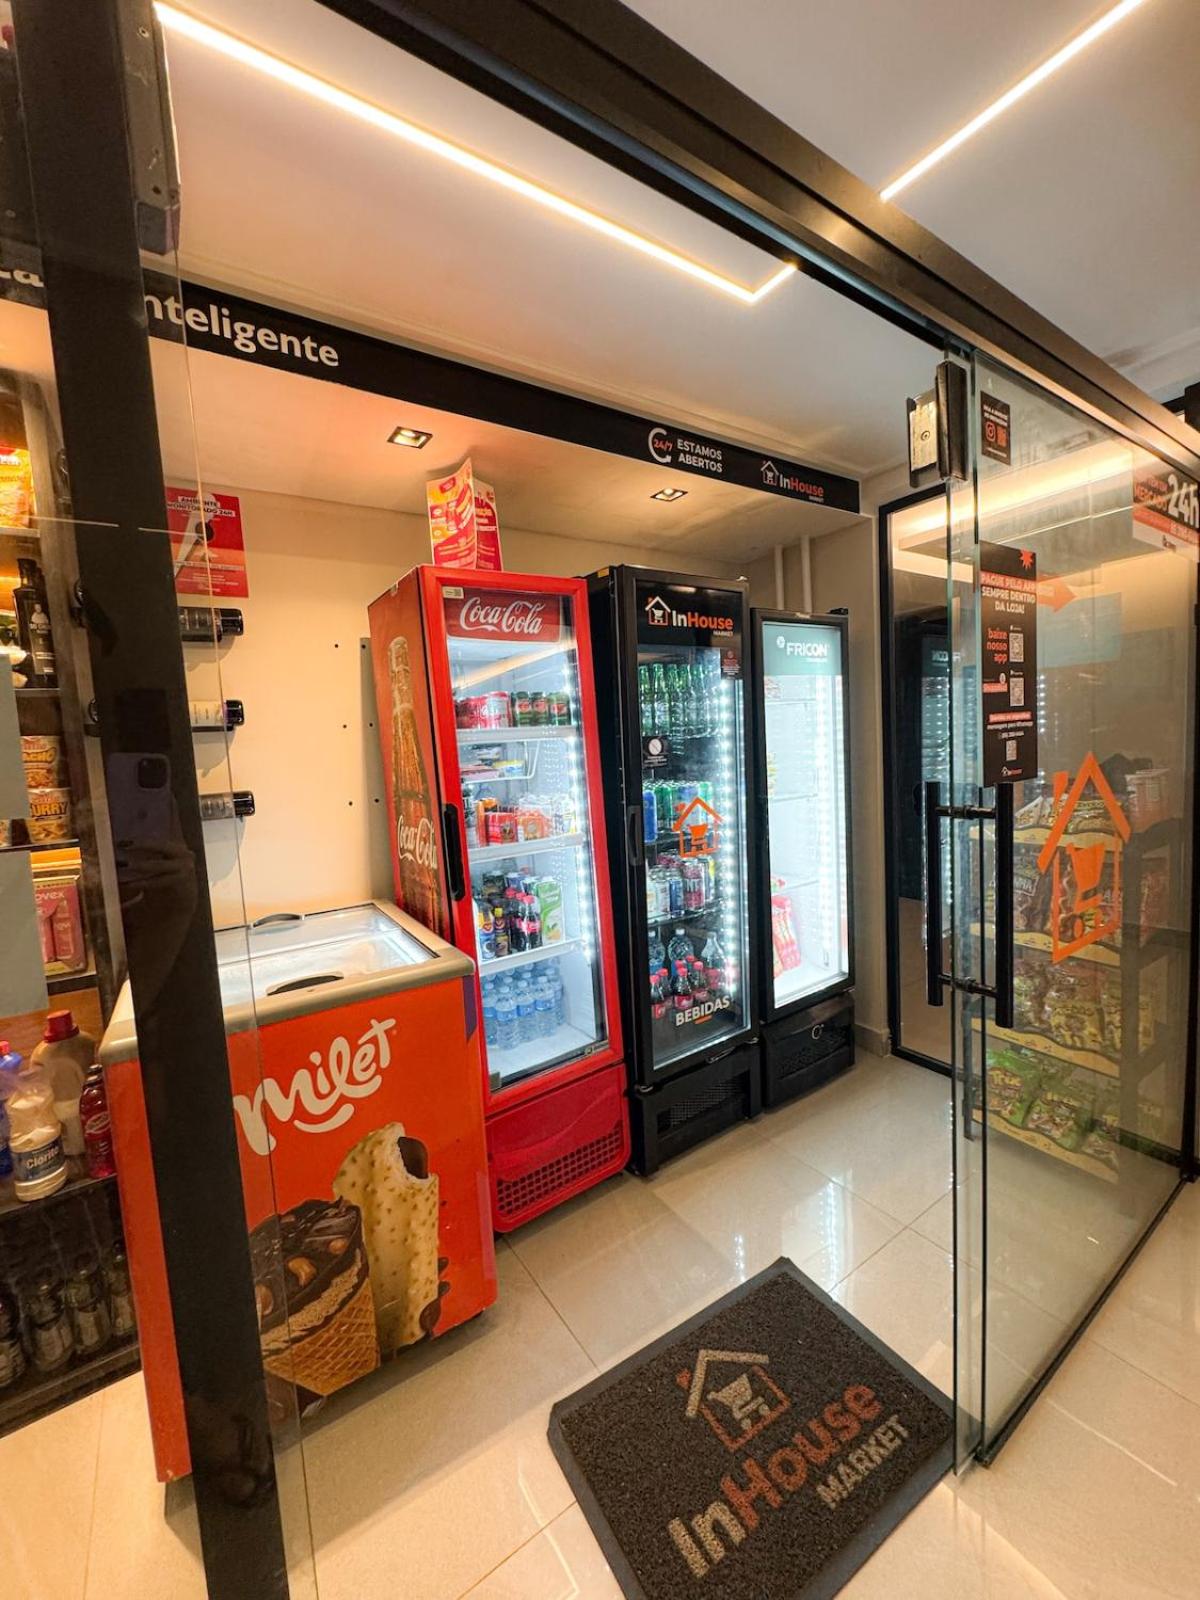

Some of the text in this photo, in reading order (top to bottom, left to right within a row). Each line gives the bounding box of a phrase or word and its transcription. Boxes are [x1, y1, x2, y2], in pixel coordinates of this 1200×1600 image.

[677, 438, 722, 461] ESTAMOS
[678, 453, 723, 473] ABERTOS
[779, 473, 825, 497] InHouse
[981, 585, 1036, 604] SEMPRE DENTRO
[994, 601, 1005, 611] DA
[671, 610, 734, 630] InHouse
[786, 642, 828, 656] FRICON
[986, 642, 1008, 651] nosso
[30, 802, 67, 818] URRY
[675, 995, 731, 1026] BEBIDAS
[815, 1414, 910, 1510] MARKET
[667, 1384, 883, 1578] InHouse
